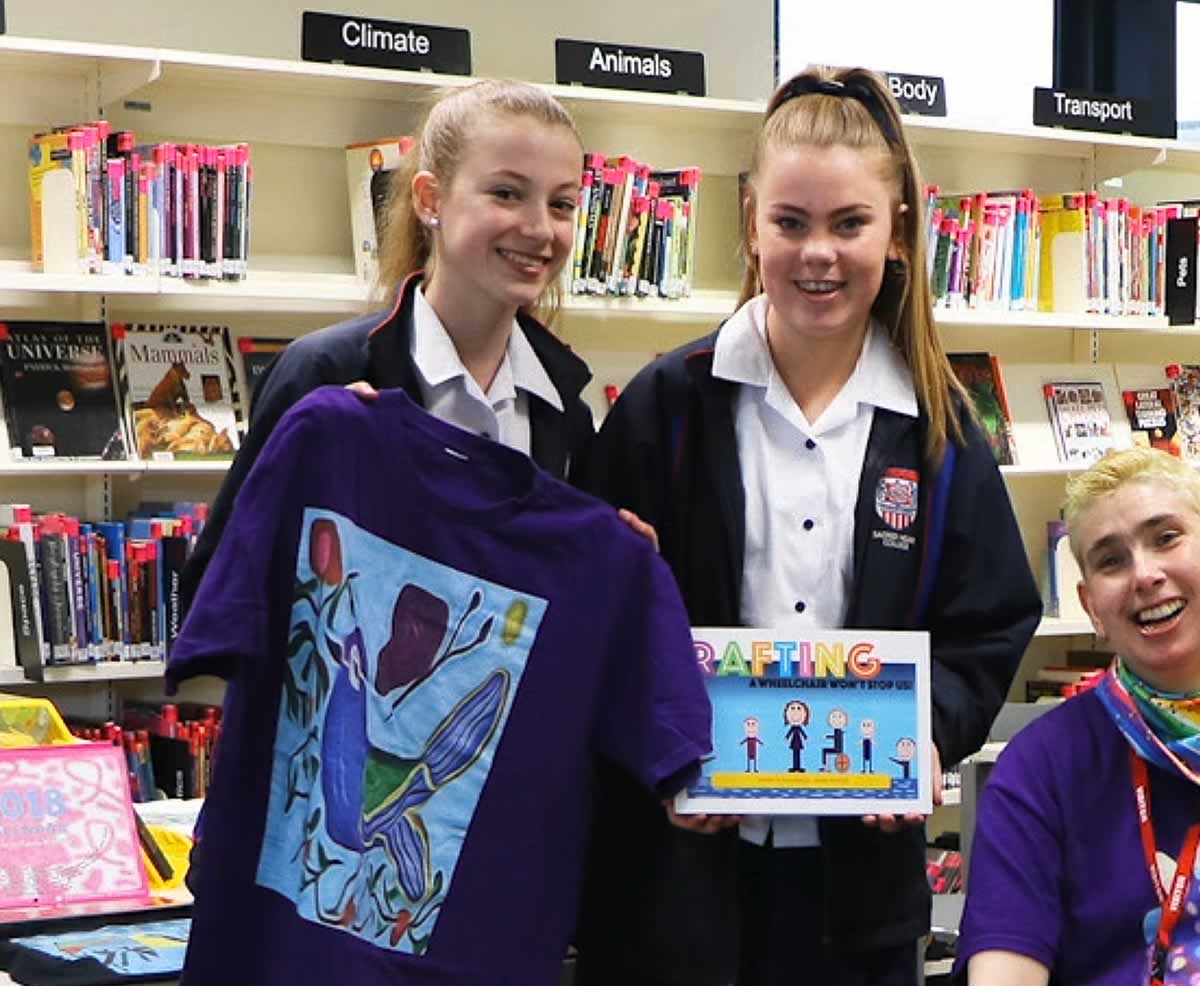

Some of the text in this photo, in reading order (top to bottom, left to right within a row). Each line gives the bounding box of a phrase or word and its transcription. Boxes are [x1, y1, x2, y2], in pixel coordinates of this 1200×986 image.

[341, 20, 431, 55] Climate
[588, 46, 673, 79] Animals
[888, 76, 938, 102] Body
[1053, 91, 1133, 123] Transport
[1176, 257, 1189, 288] Pets
[7, 344, 104, 360] UNIVERSE
[130, 344, 220, 365] Mammals
[169, 570, 181, 639] Weather
[691, 640, 883, 680] RAFTING
[757, 679, 827, 689] WHEELCHAIR
[829, 680, 866, 690] WON'T
[868, 681, 893, 690] STOP
